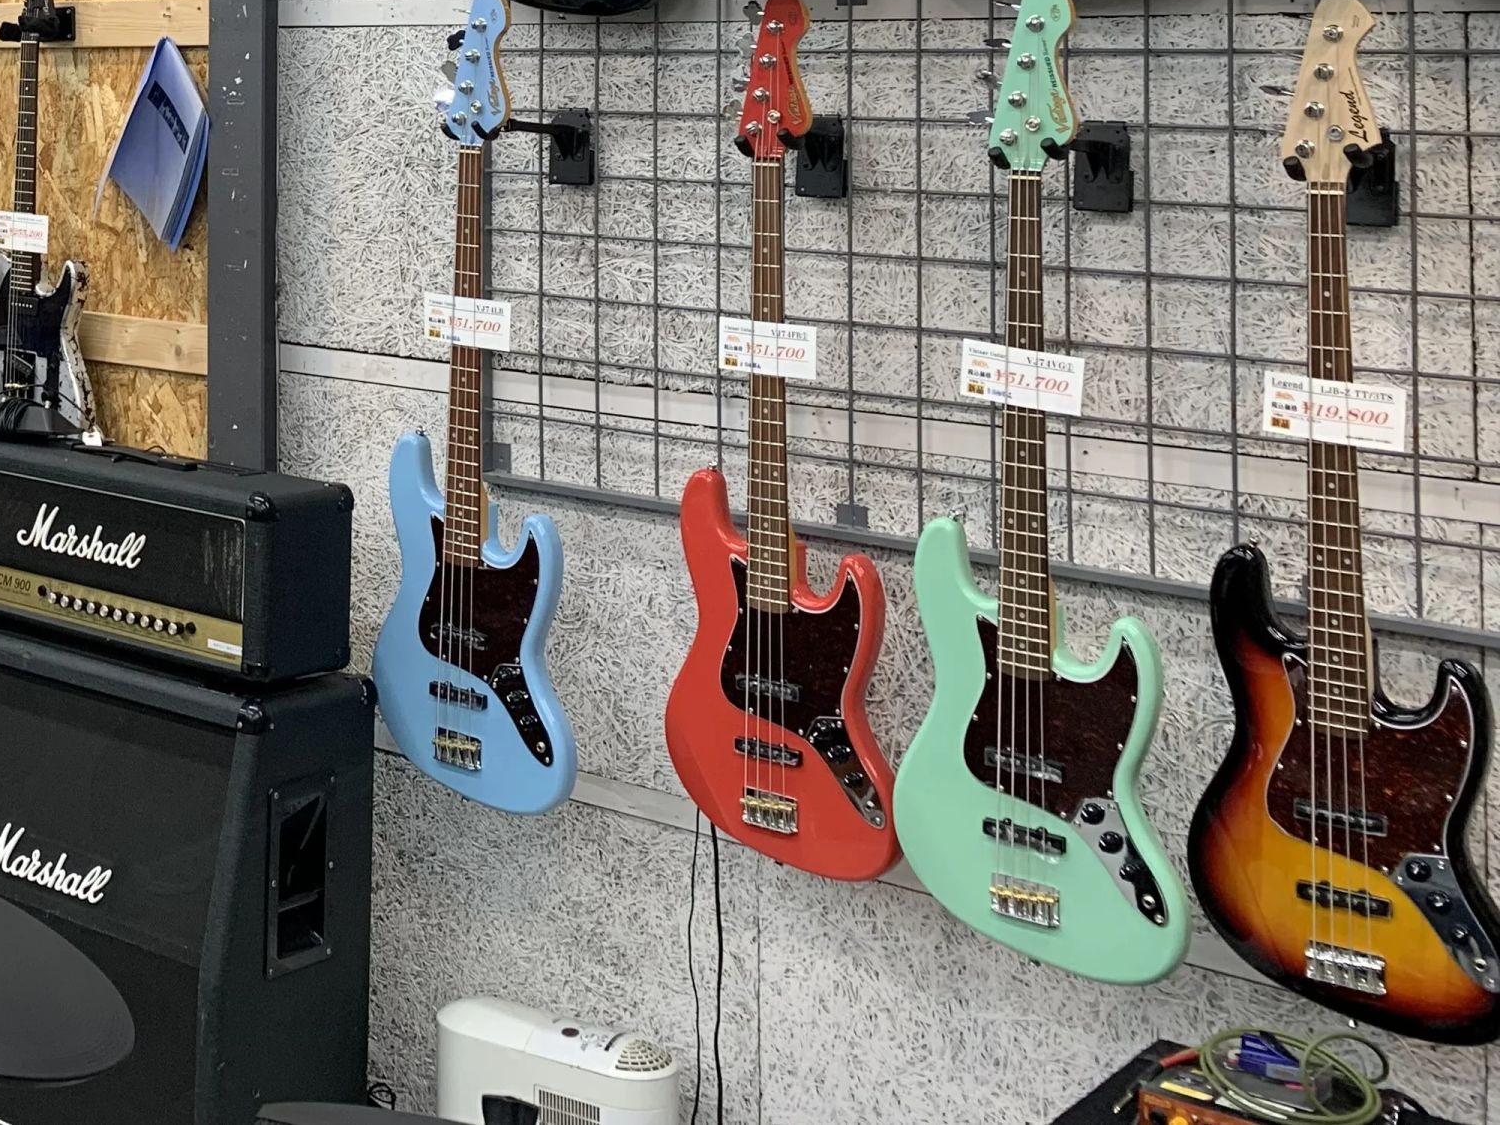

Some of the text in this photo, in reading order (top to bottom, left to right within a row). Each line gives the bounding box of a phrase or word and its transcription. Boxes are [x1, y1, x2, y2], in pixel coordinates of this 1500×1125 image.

[1339, 89, 1370, 144] Legend
[746, 341, 806, 360] ¥51,700
[995, 369, 1070, 394] ¥51,700
[1271, 377, 1304, 390] Legend
[1302, 400, 1389, 426] ¥19,800
[16, 502, 147, 569] Marshall
[13, 577, 32, 592] 900
